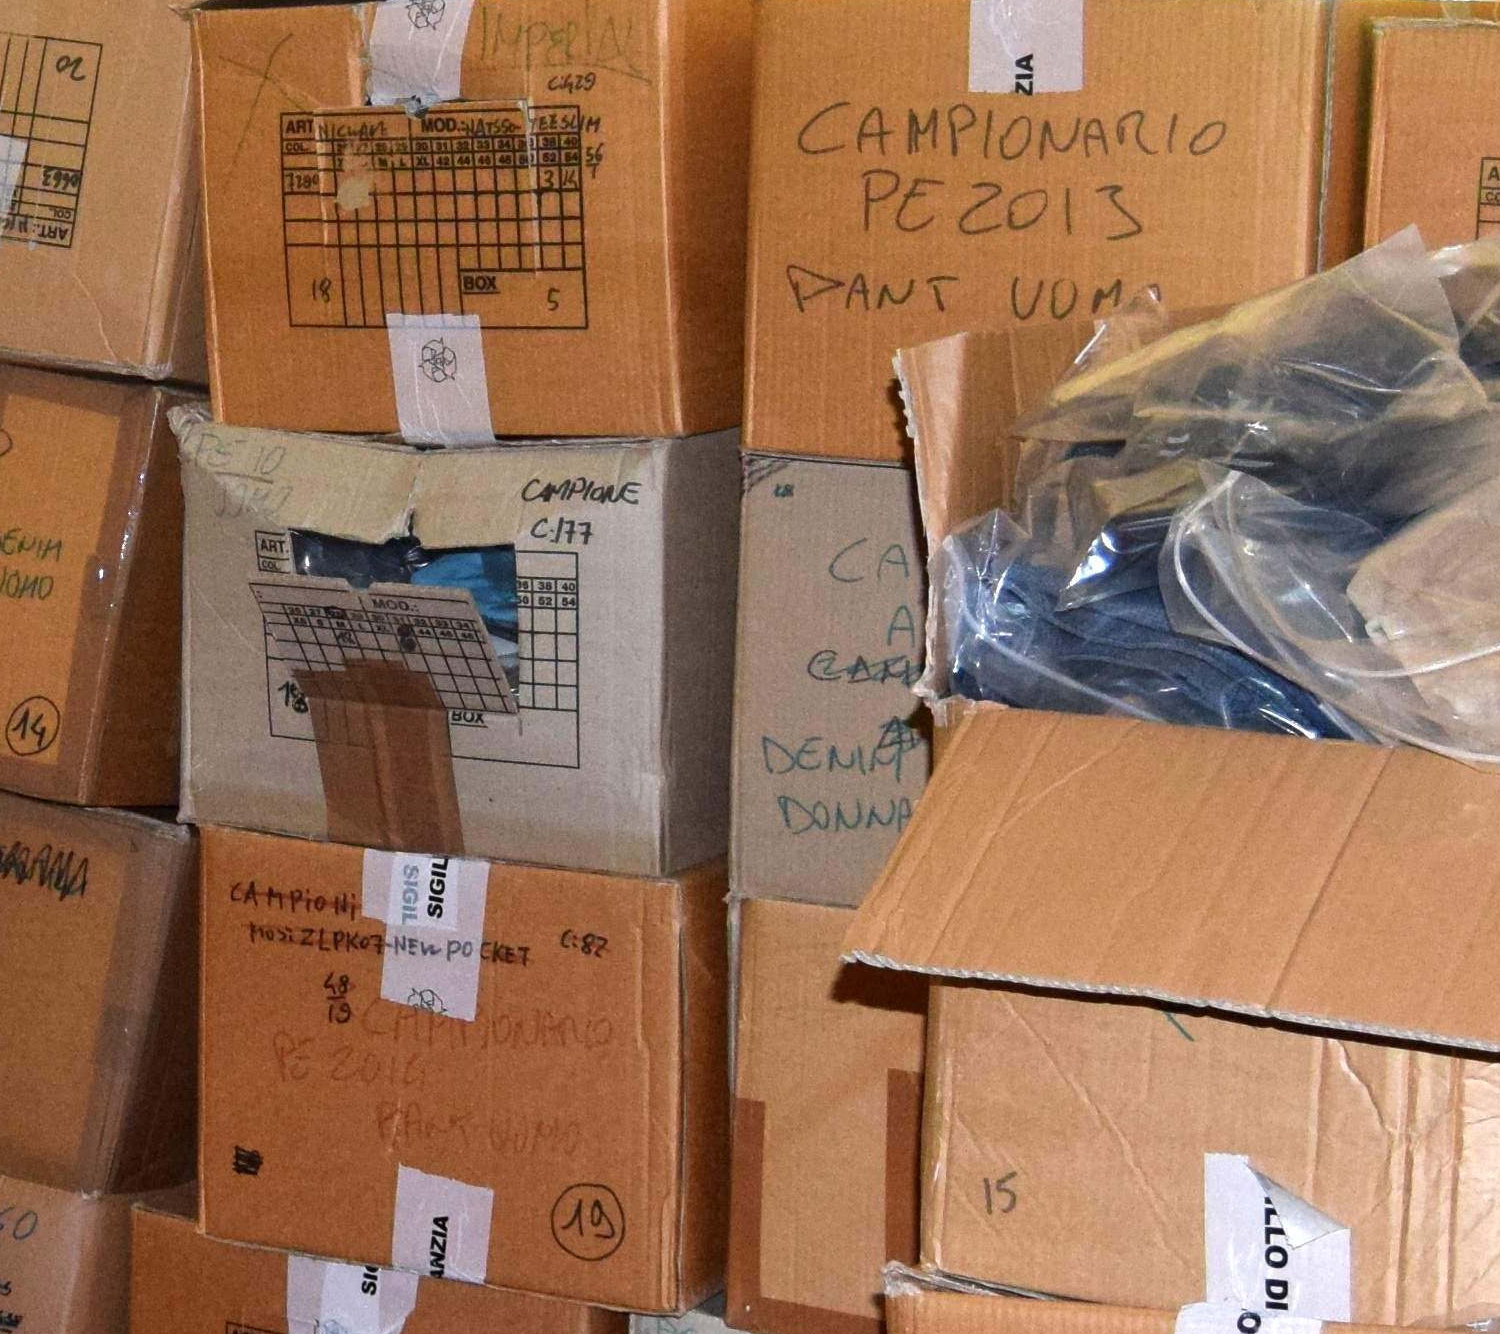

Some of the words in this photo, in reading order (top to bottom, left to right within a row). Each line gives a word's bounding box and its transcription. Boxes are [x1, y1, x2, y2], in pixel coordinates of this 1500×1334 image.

[797, 100, 1228, 161] CAMPIONARIO
[861, 168, 944, 232] PE
[958, 180, 1143, 241] 2013
[311, 277, 332, 302] 18
[462, 275, 498, 291] BOX
[546, 288, 560, 311] 5
[785, 263, 960, 312] PANT
[520, 476, 642, 506] CAMPIONE
[13, 708, 47, 750] 14
[982, 1171, 1018, 1215] 15
[560, 1199, 615, 1239] 19
[1265, 1275, 1289, 1312] DI
